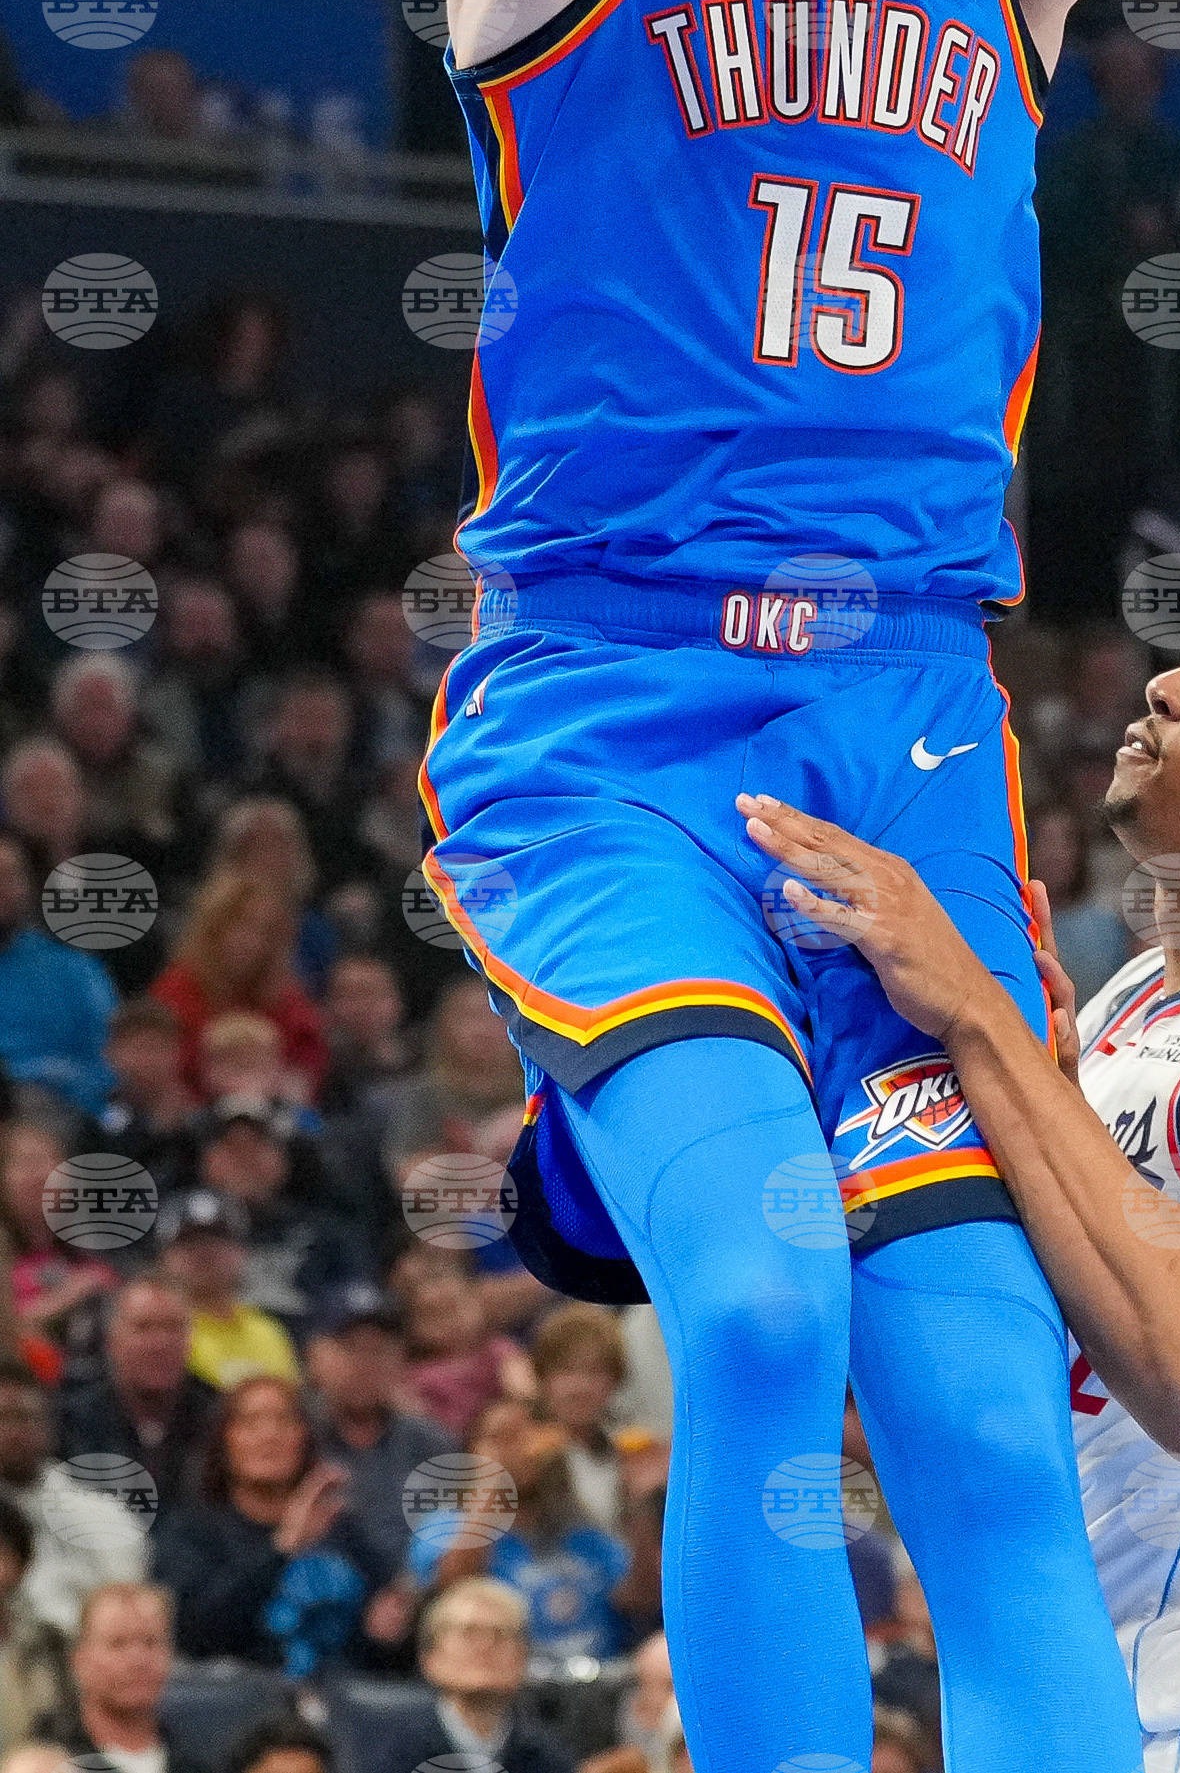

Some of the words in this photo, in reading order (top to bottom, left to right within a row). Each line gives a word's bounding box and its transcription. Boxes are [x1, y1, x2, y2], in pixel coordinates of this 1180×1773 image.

[748, 173, 921, 375] 15
[720, 589, 818, 655] OKC
[875, 1071, 959, 1136] OKC
